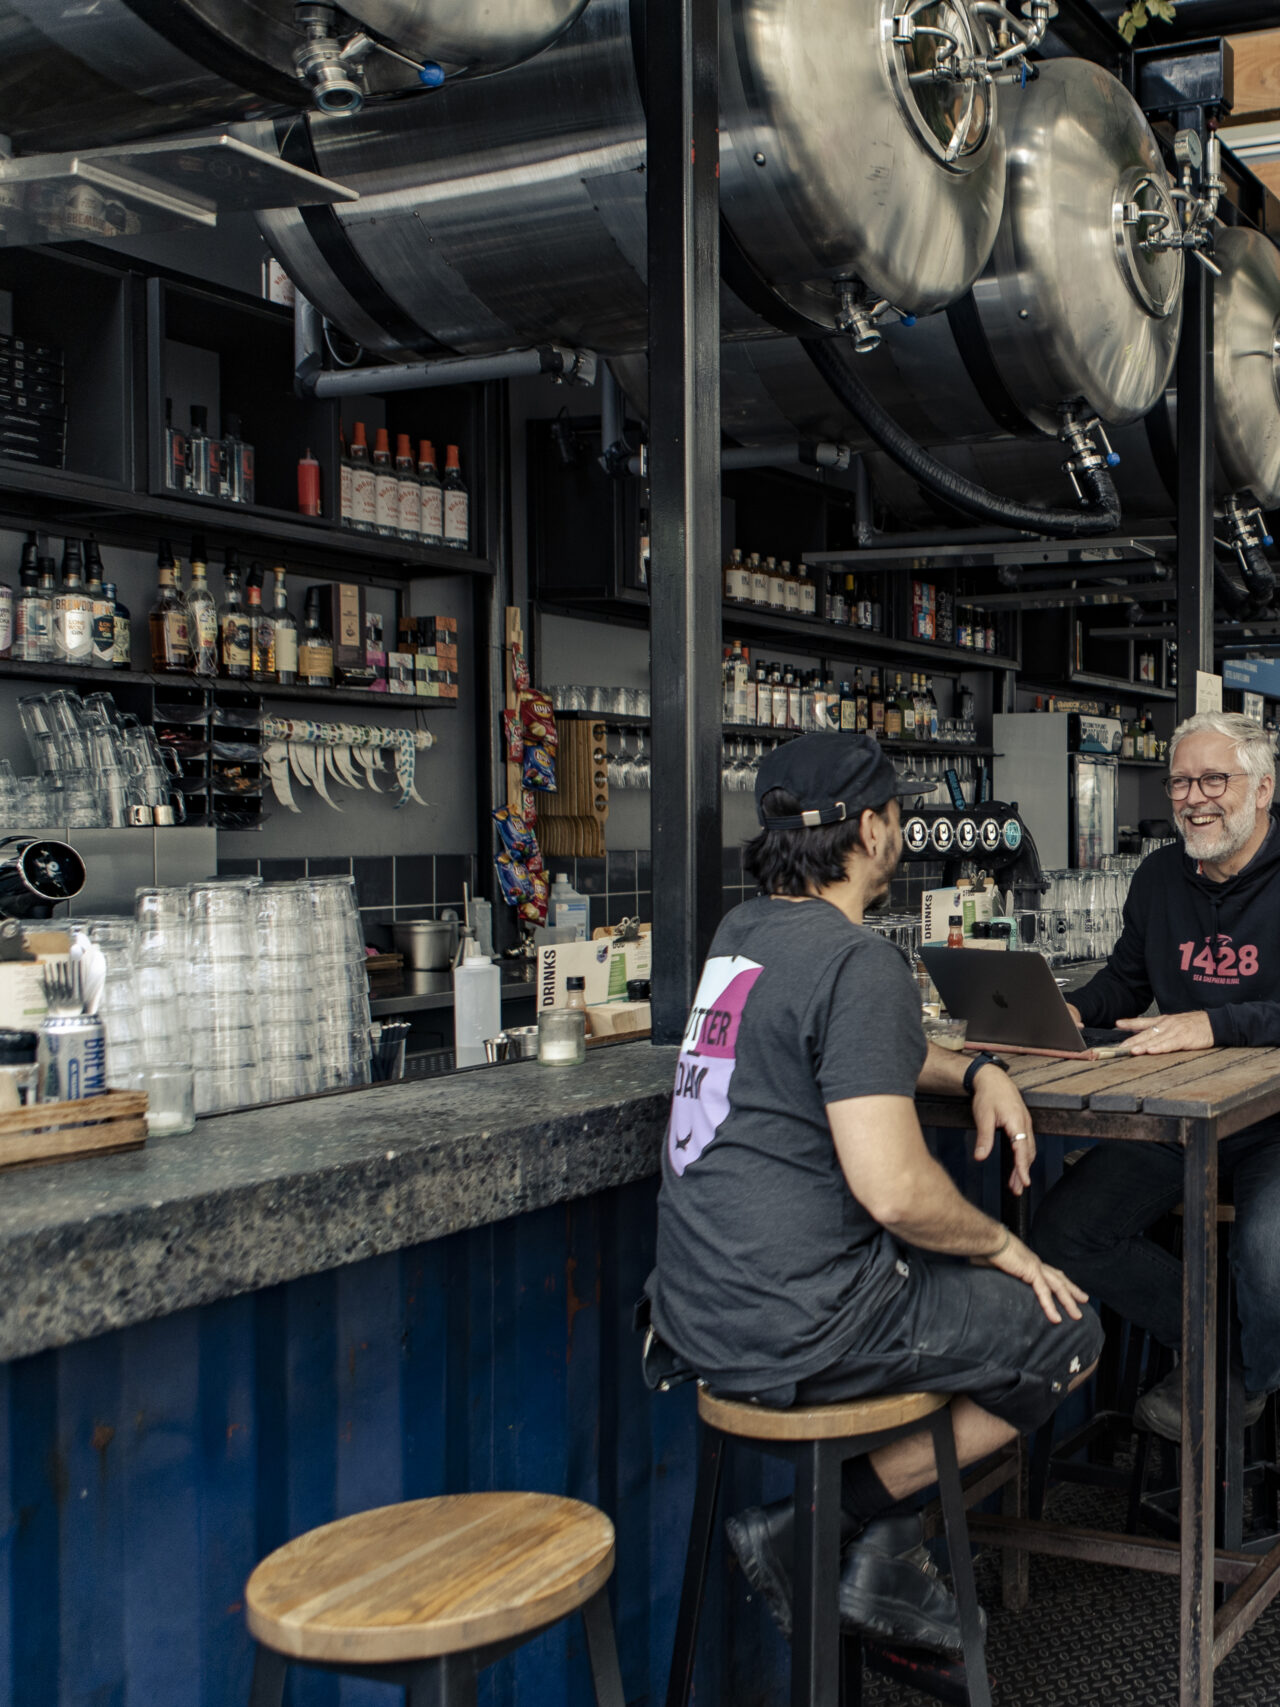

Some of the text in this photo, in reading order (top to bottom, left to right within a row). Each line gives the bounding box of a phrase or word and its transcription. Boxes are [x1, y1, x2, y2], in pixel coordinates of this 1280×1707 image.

[925, 894, 933, 939] DRINKS
[543, 949, 556, 1006] DRINKS
[1179, 941, 1259, 976] 1428
